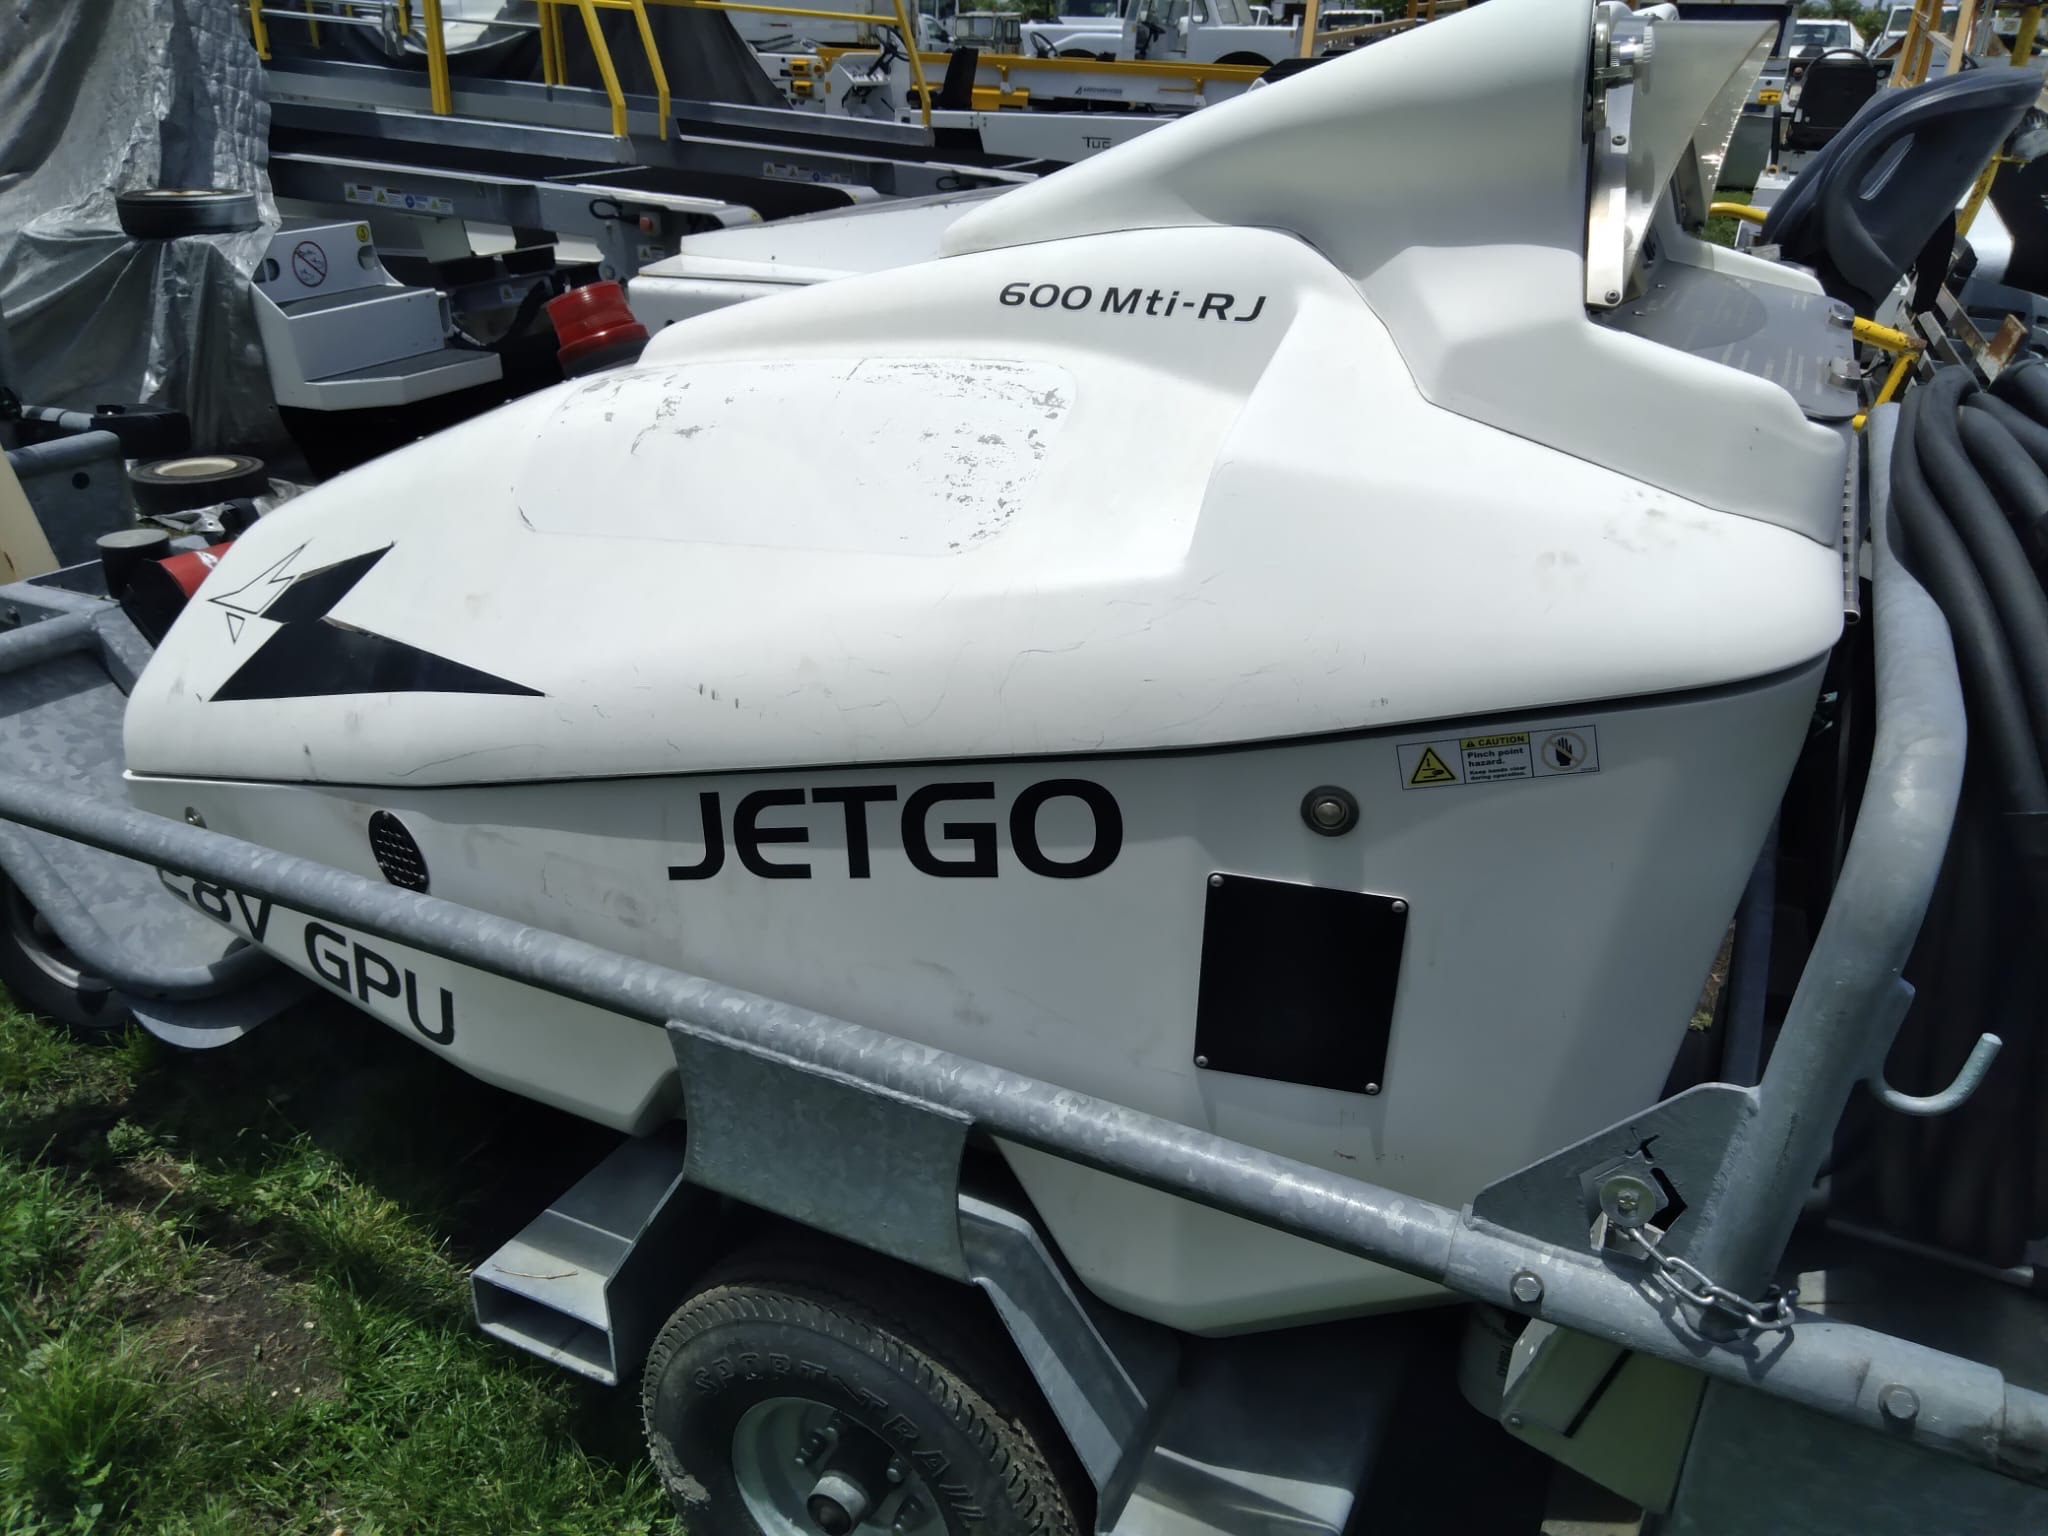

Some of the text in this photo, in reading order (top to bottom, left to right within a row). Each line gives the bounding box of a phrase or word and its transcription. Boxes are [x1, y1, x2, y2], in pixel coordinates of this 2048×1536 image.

[998, 282, 1267, 322] 600 Mti-RJ
[1467, 747, 1524, 759] Pinch point
[1478, 735, 1525, 747] CAUTION
[1468, 758, 1505, 767] hazard.
[668, 778, 1124, 881] JETGO
[304, 921, 455, 1046] GPU
